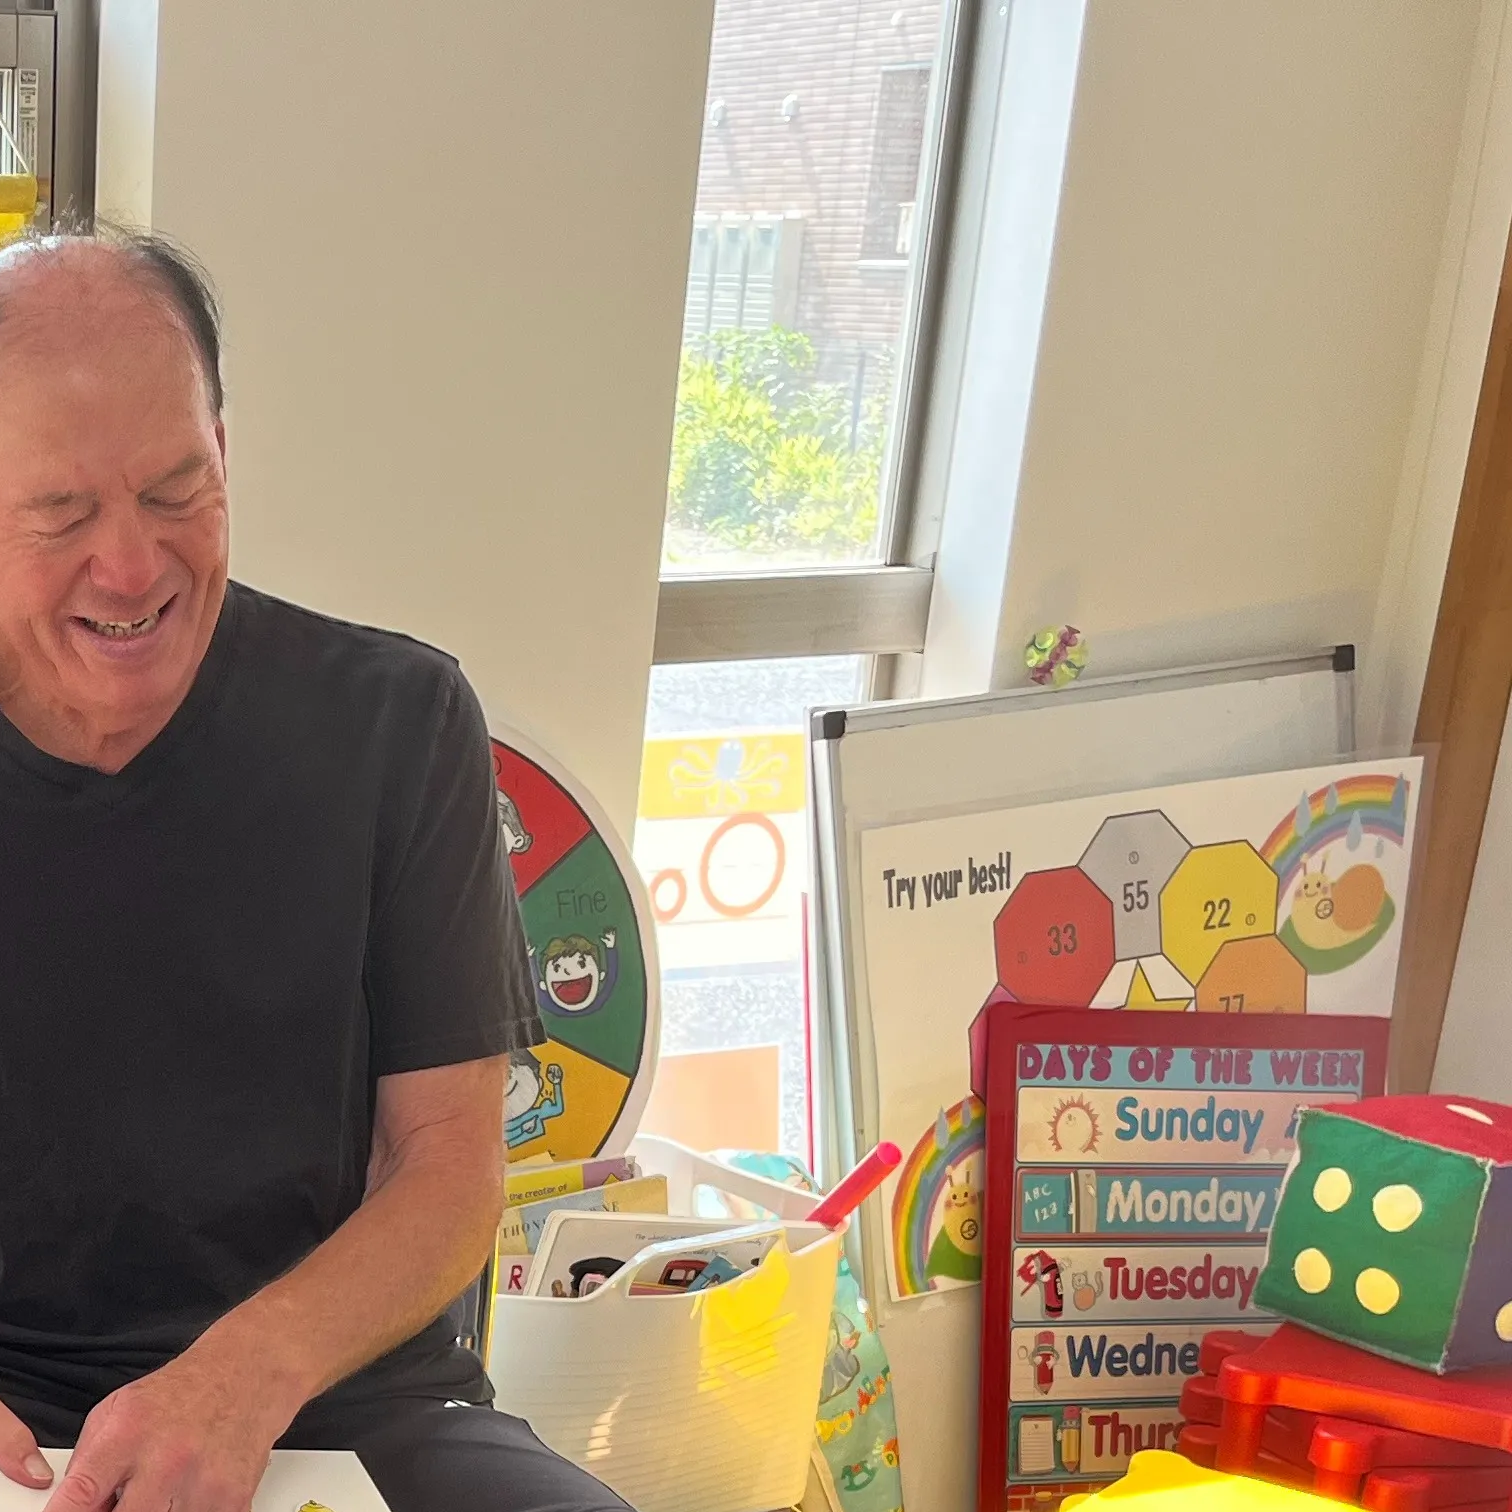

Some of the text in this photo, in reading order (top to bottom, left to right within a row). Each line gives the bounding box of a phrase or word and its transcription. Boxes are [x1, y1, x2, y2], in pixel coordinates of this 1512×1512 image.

[883, 851, 1012, 910] Try your best!
[1122, 880, 1149, 913] 55
[555, 889, 608, 919] Fine
[1202, 897, 1231, 931] 22
[1046, 923, 1078, 956] 33
[1018, 1045, 1361, 1088] DAYS OF THE WEEK
[1115, 1096, 1265, 1154] Sunday
[524, 1187, 556, 1199] creator
[558, 1184, 568, 1193] of
[1024, 1184, 1053, 1204] ABC
[1106, 1176, 1266, 1233] Monday
[502, 1217, 547, 1240] THON
[1034, 1201, 1058, 1224] 123
[1103, 1253, 1260, 1311] Tuesday
[1066, 1332, 1201, 1378] Wedne
[1088, 1411, 1186, 1458] Thur
